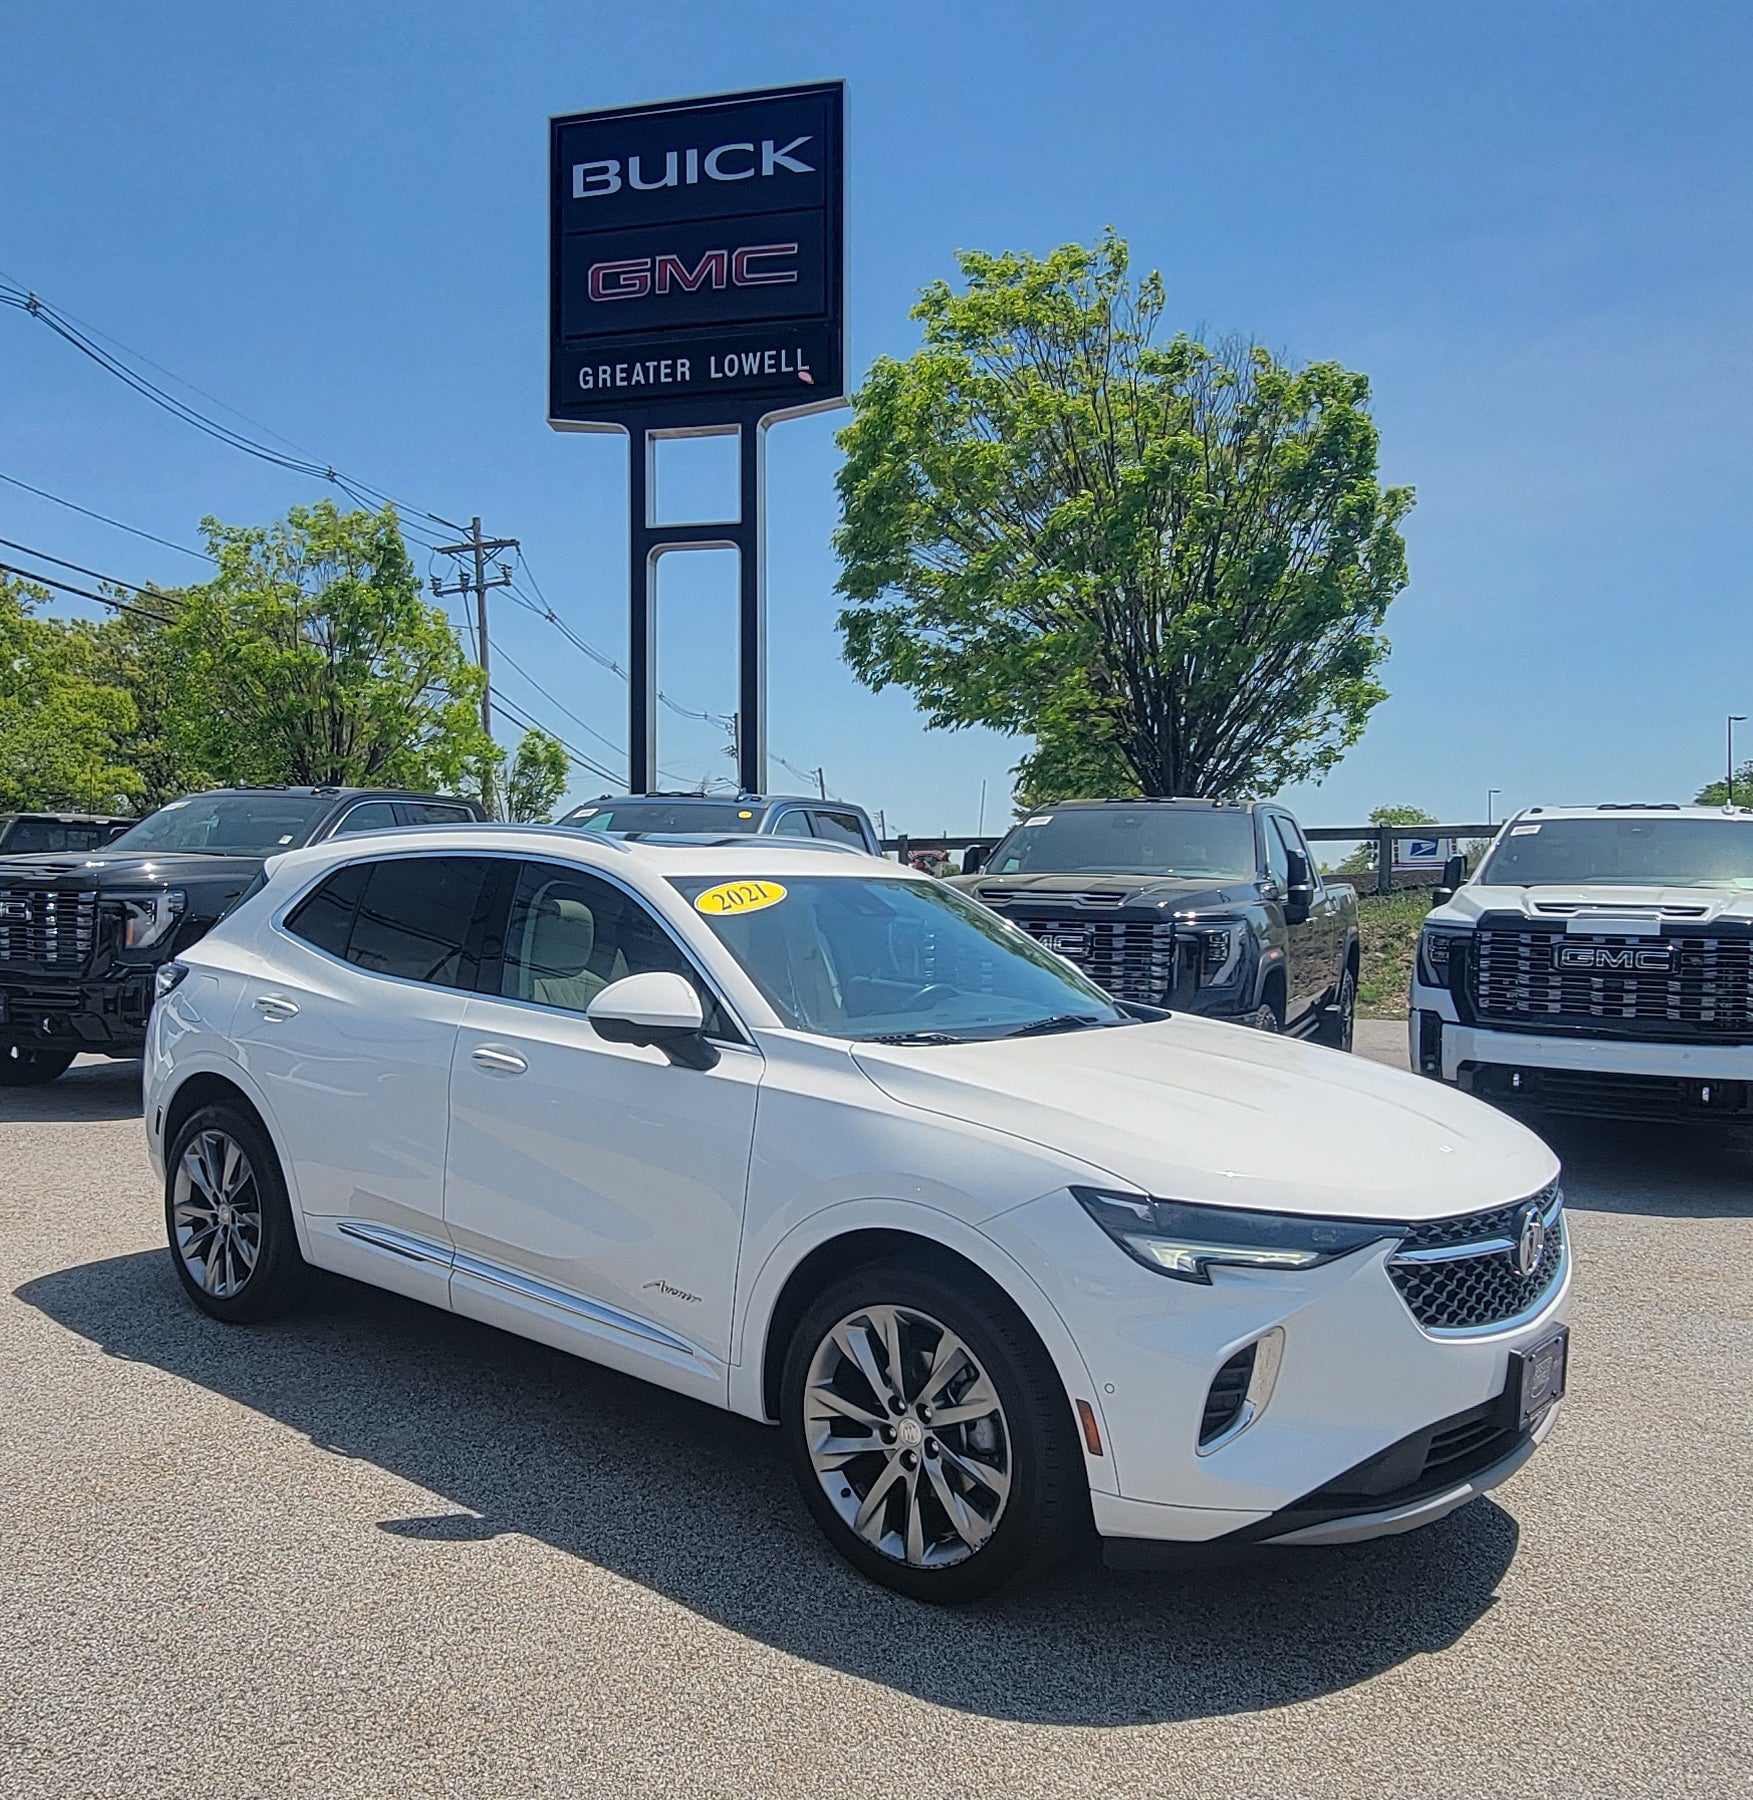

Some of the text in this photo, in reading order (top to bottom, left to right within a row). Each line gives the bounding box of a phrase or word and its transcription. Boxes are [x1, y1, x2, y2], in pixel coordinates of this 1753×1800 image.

[572, 136, 816, 199] BUICK
[588, 242, 798, 302] GMC
[579, 348, 810, 390] GREATER LOWELL
[712, 883, 769, 911] 2021
[1561, 948, 1670, 970] GMC
